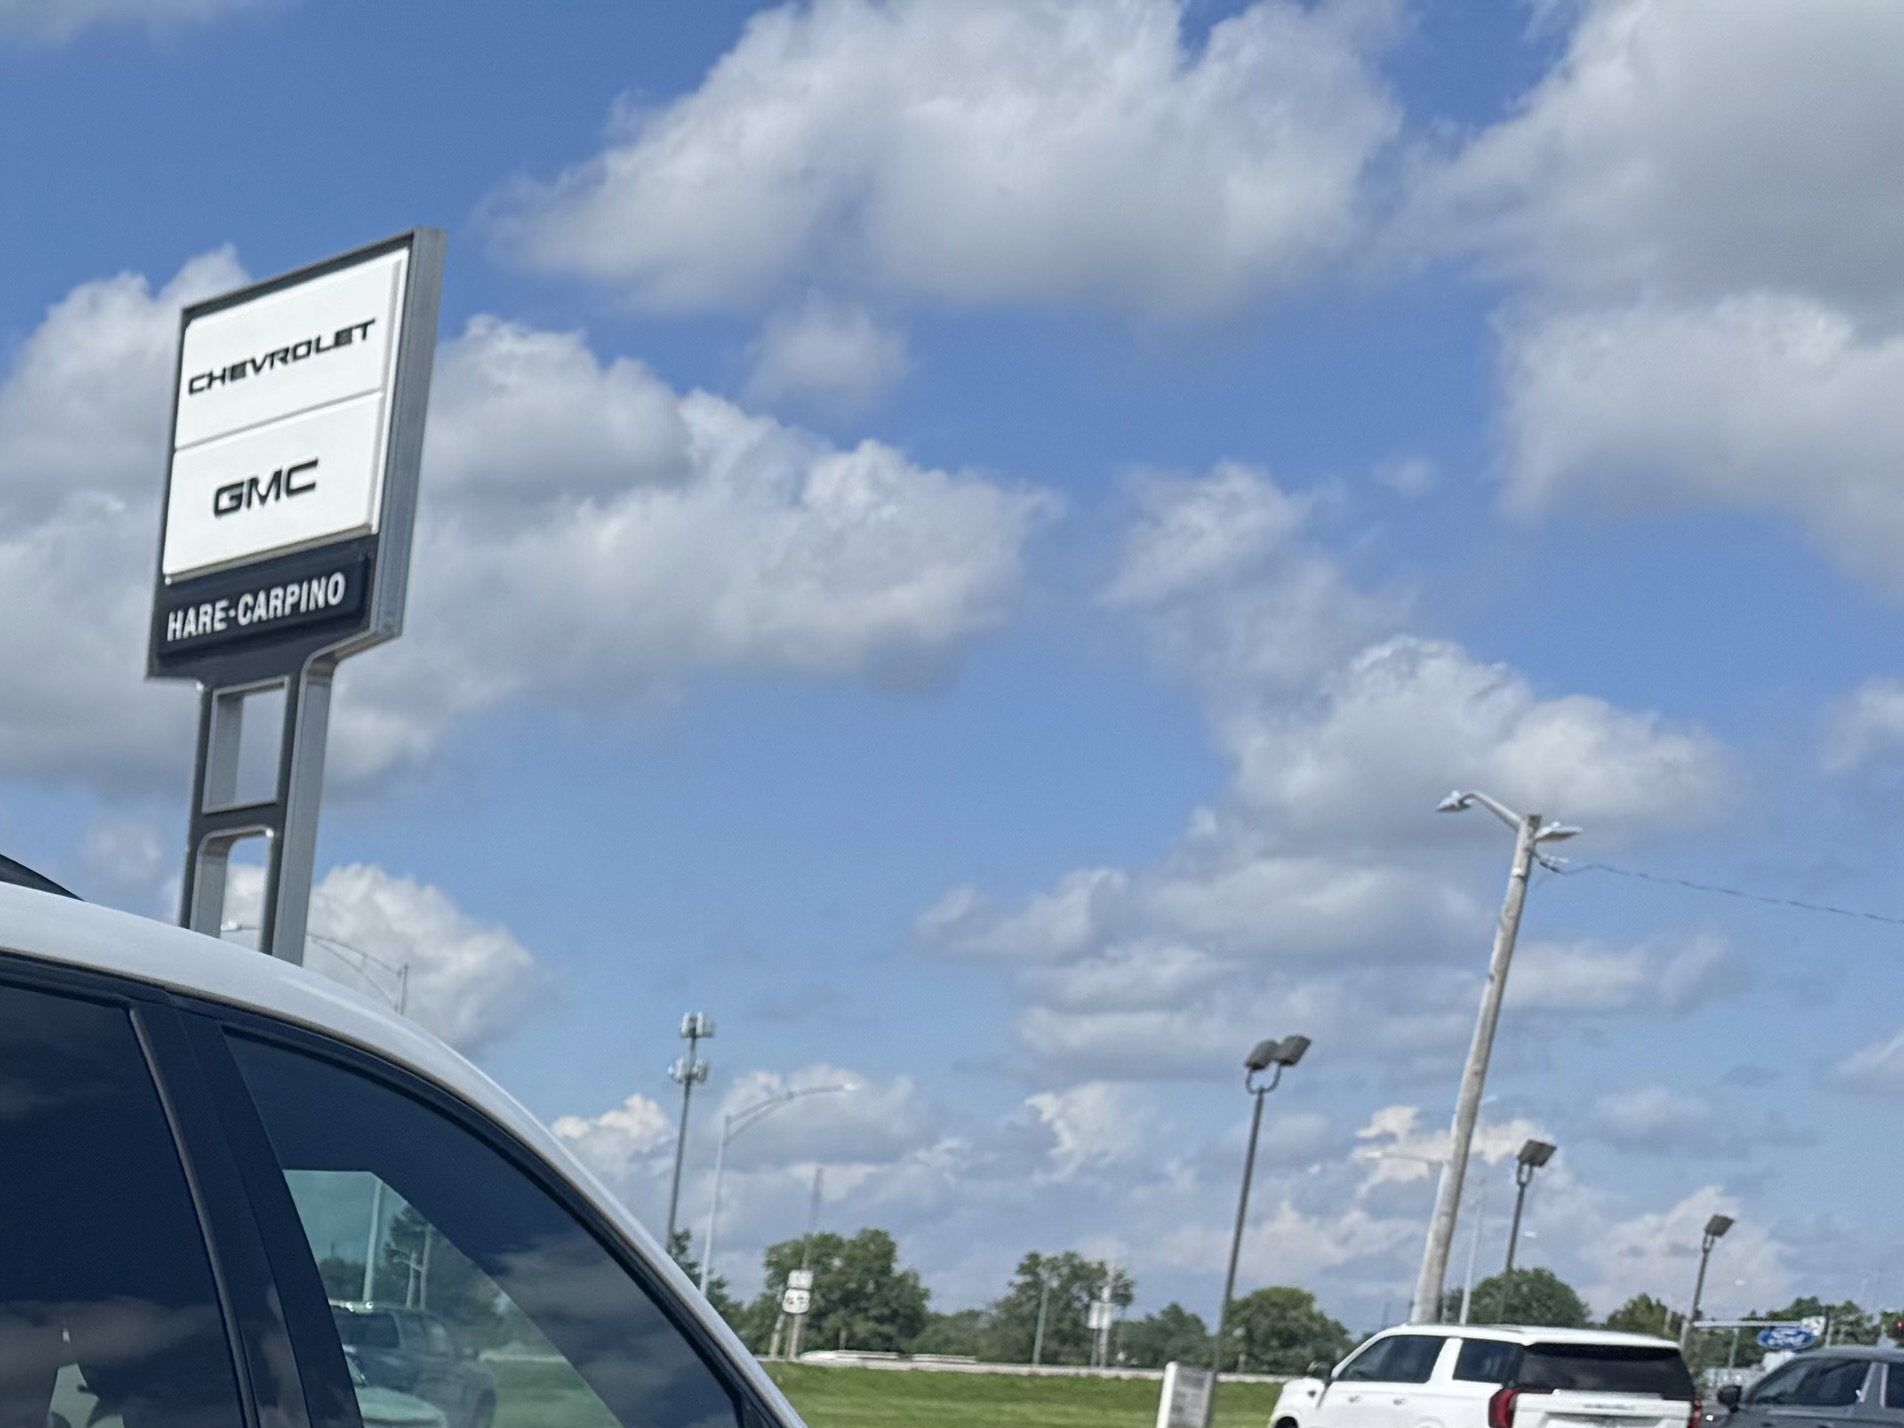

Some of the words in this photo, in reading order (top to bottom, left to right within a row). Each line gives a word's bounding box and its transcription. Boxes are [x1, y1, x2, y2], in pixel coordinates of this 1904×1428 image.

[188, 318, 376, 396] CHEVROLET
[214, 457, 319, 518] GMC
[167, 571, 346, 642] HARE-CARPINO
